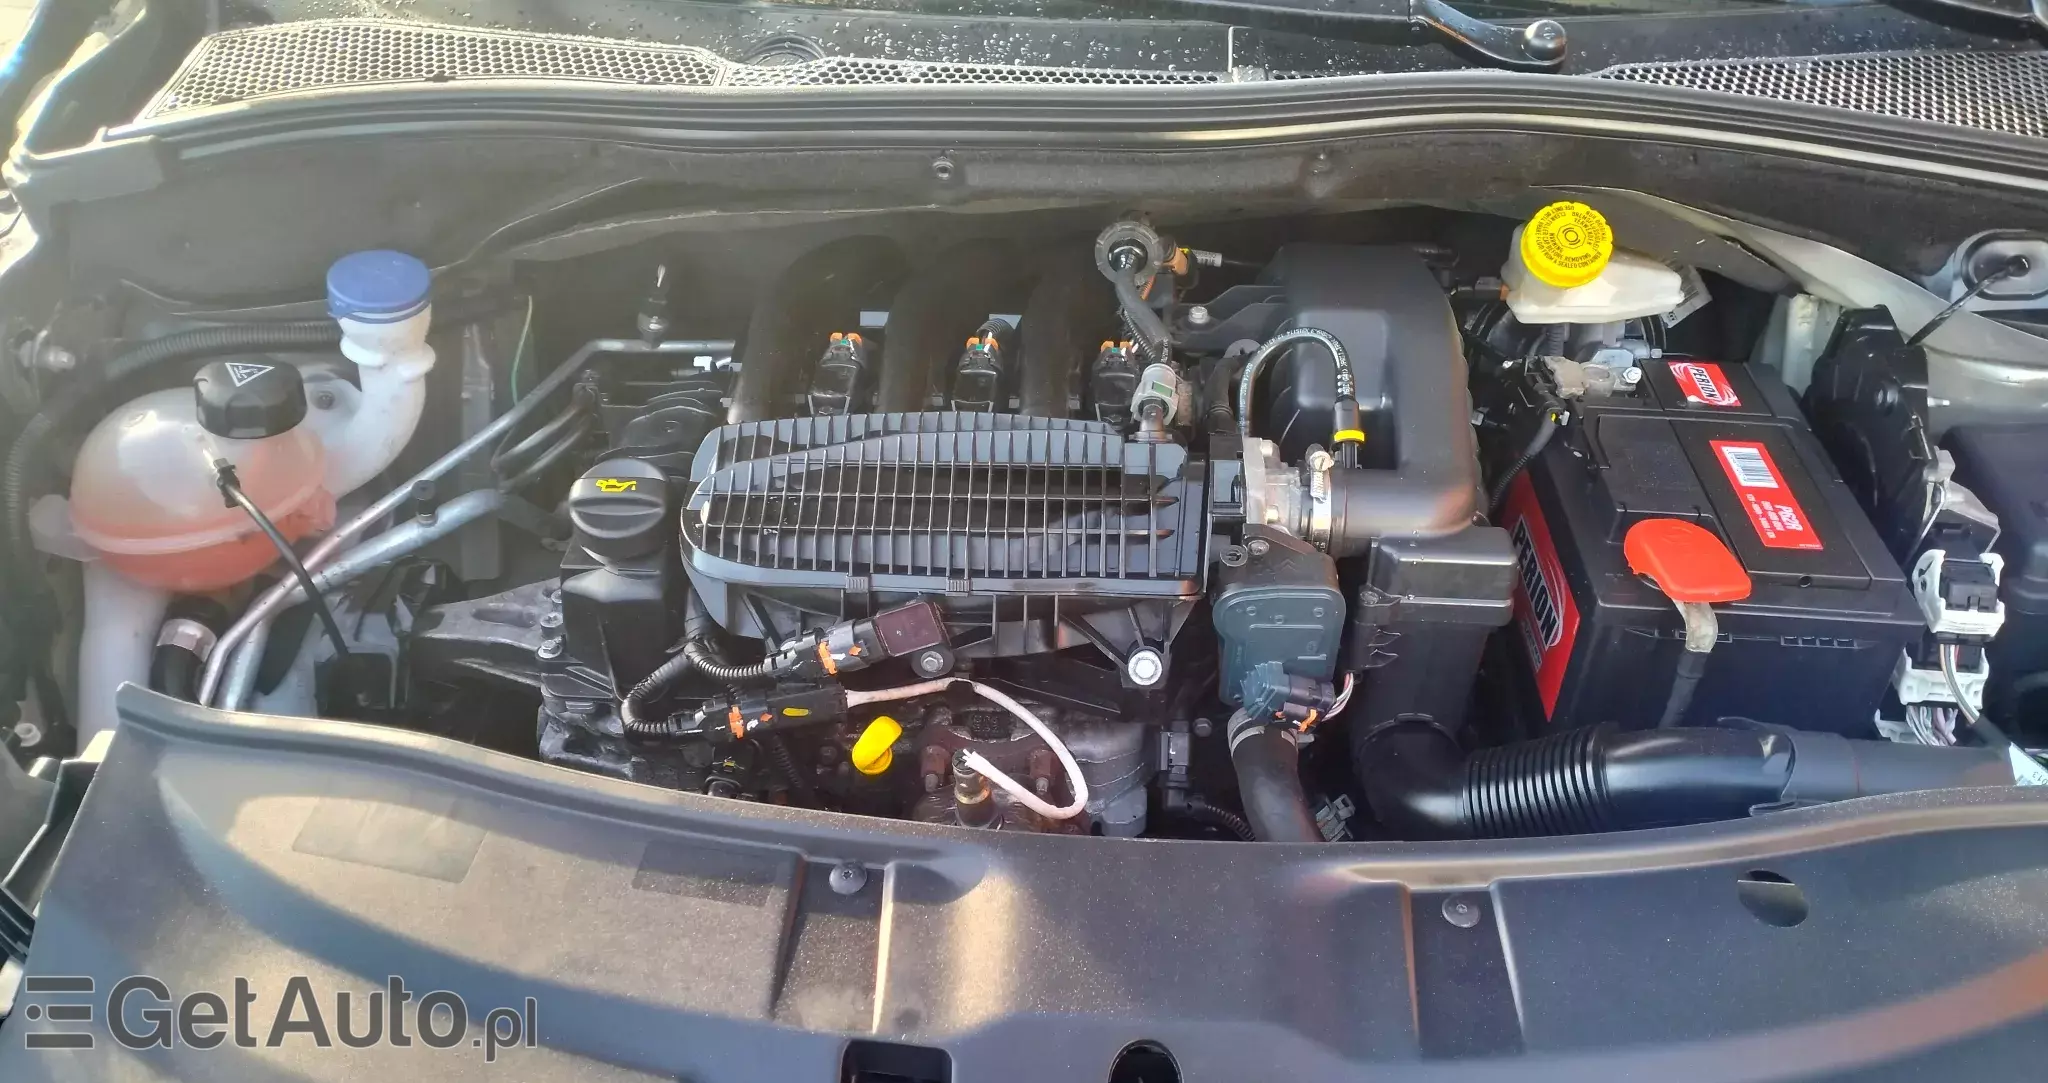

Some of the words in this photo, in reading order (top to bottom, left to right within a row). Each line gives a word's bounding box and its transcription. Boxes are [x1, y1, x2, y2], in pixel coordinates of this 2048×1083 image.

[1546, 244, 1563, 260] BEFORE
[1565, 252, 1591, 262] REMOVING
[1690, 367, 1719, 399] PERION
[1774, 504, 1803, 531] P62R
[1513, 520, 1557, 645] PERION
